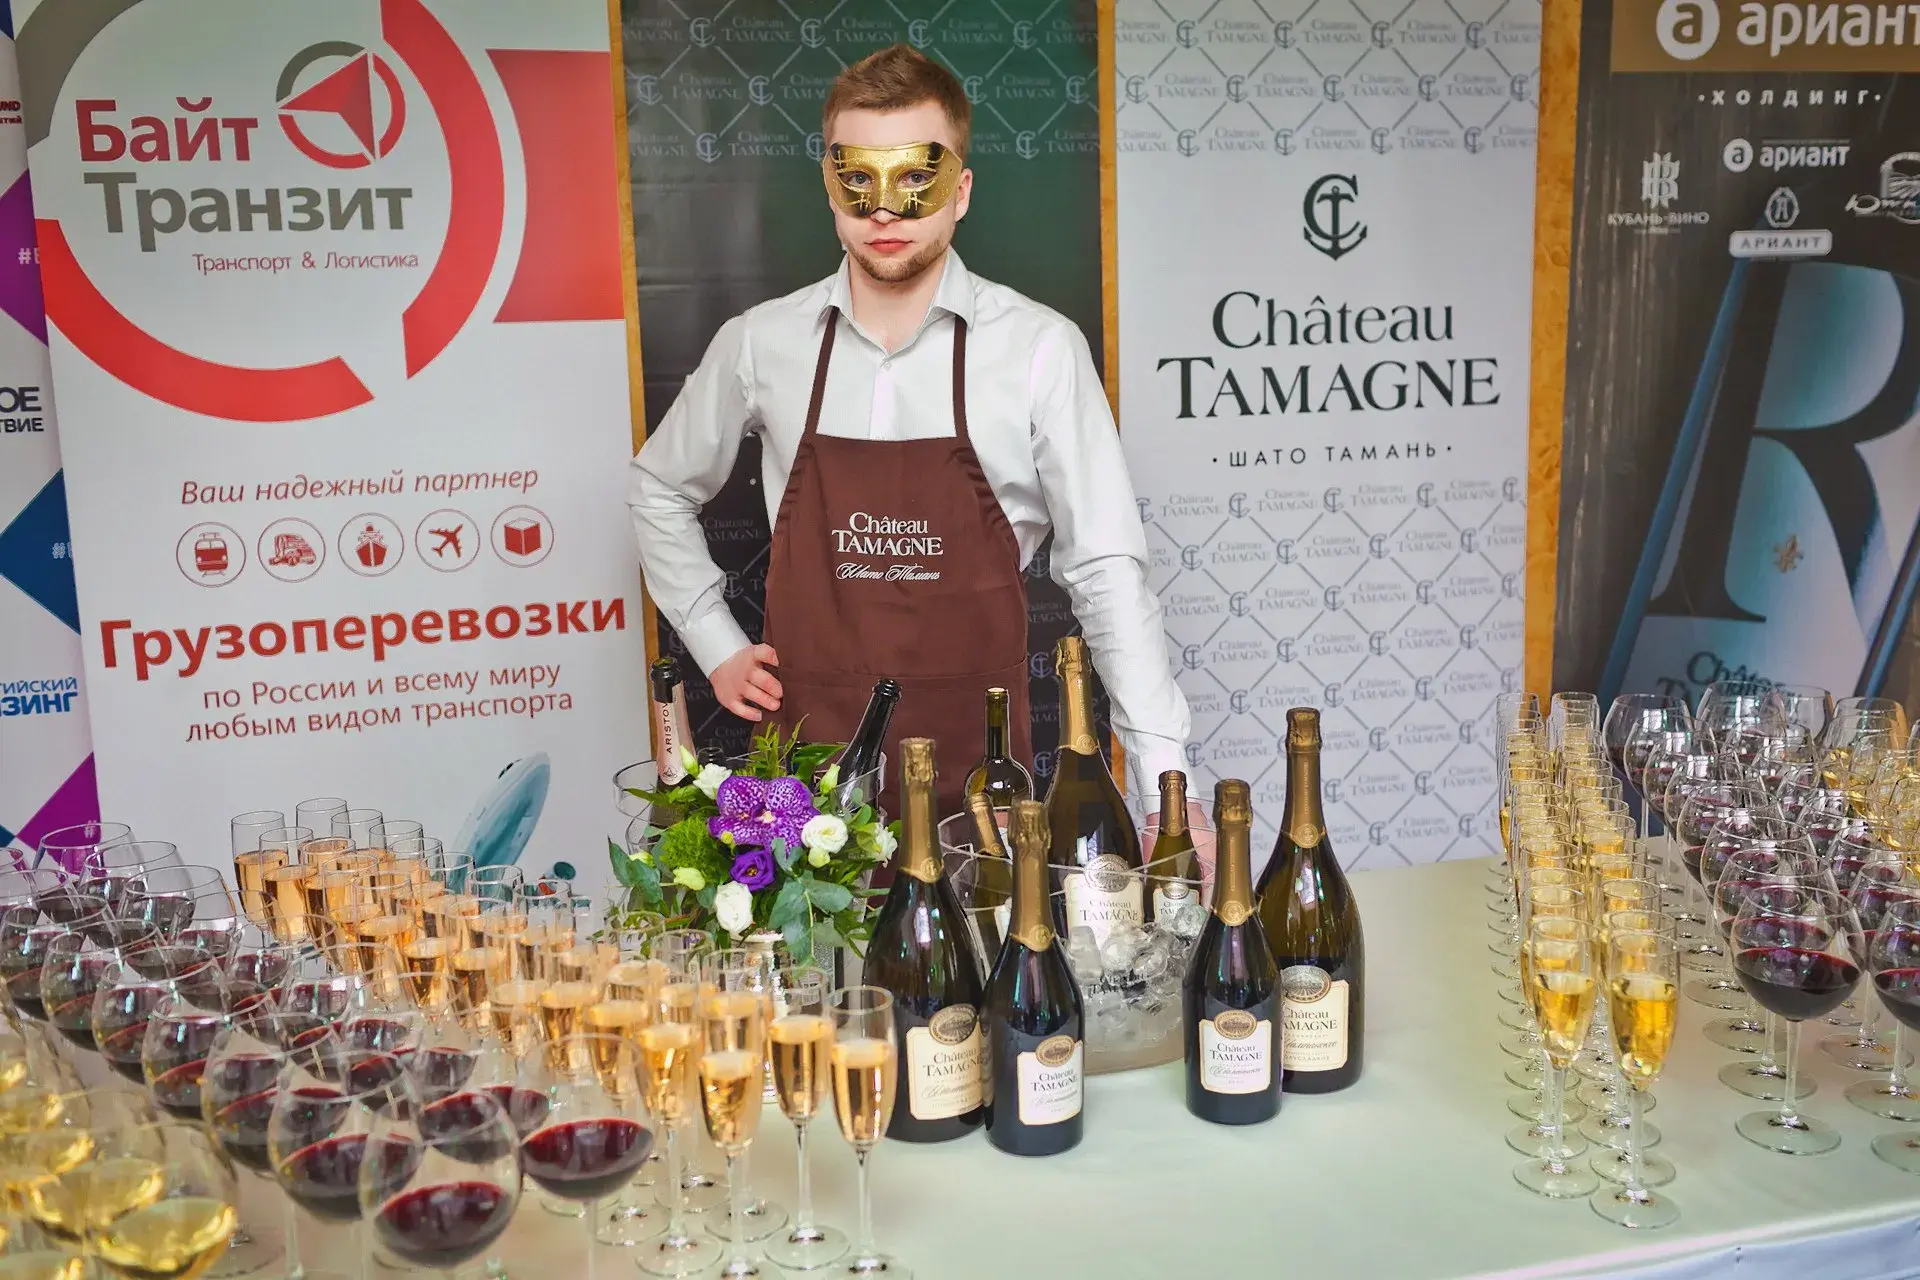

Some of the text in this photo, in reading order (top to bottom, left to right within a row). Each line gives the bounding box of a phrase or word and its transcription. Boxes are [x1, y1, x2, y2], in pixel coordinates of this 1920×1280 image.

[1115, 30, 1169, 43] AMAGNE
[75, 96, 259, 163] Байт
[1116, 140, 1171, 152] AMAGNE
[1759, 145, 1850, 172] ариант
[84, 172, 413, 253] Транзит
[1740, 236, 1824, 249] АРИАНТ
[192, 251, 420, 277] Транспорт & Логистика
[1212, 290, 1455, 349] Château
[1156, 356, 1502, 420] TAMAGNE
[1229, 442, 1437, 468] ШАТО ТАМАНЬ
[181, 468, 540, 505] Ваш надежный партнер
[704, 529, 765, 541] AMAGNE
[849, 512, 928, 535] Château
[832, 529, 944, 556] TAMAGNE
[100, 598, 627, 681] Грузоперевозки
[203, 662, 562, 710] по России и всему миру
[0, 691, 78, 717] ЗИНГ
[186, 691, 574, 743] любым видом транспорта
[1284, 1019, 1338, 1031] AMAGNE
[1210, 1049, 1263, 1062] TAMAGNE
